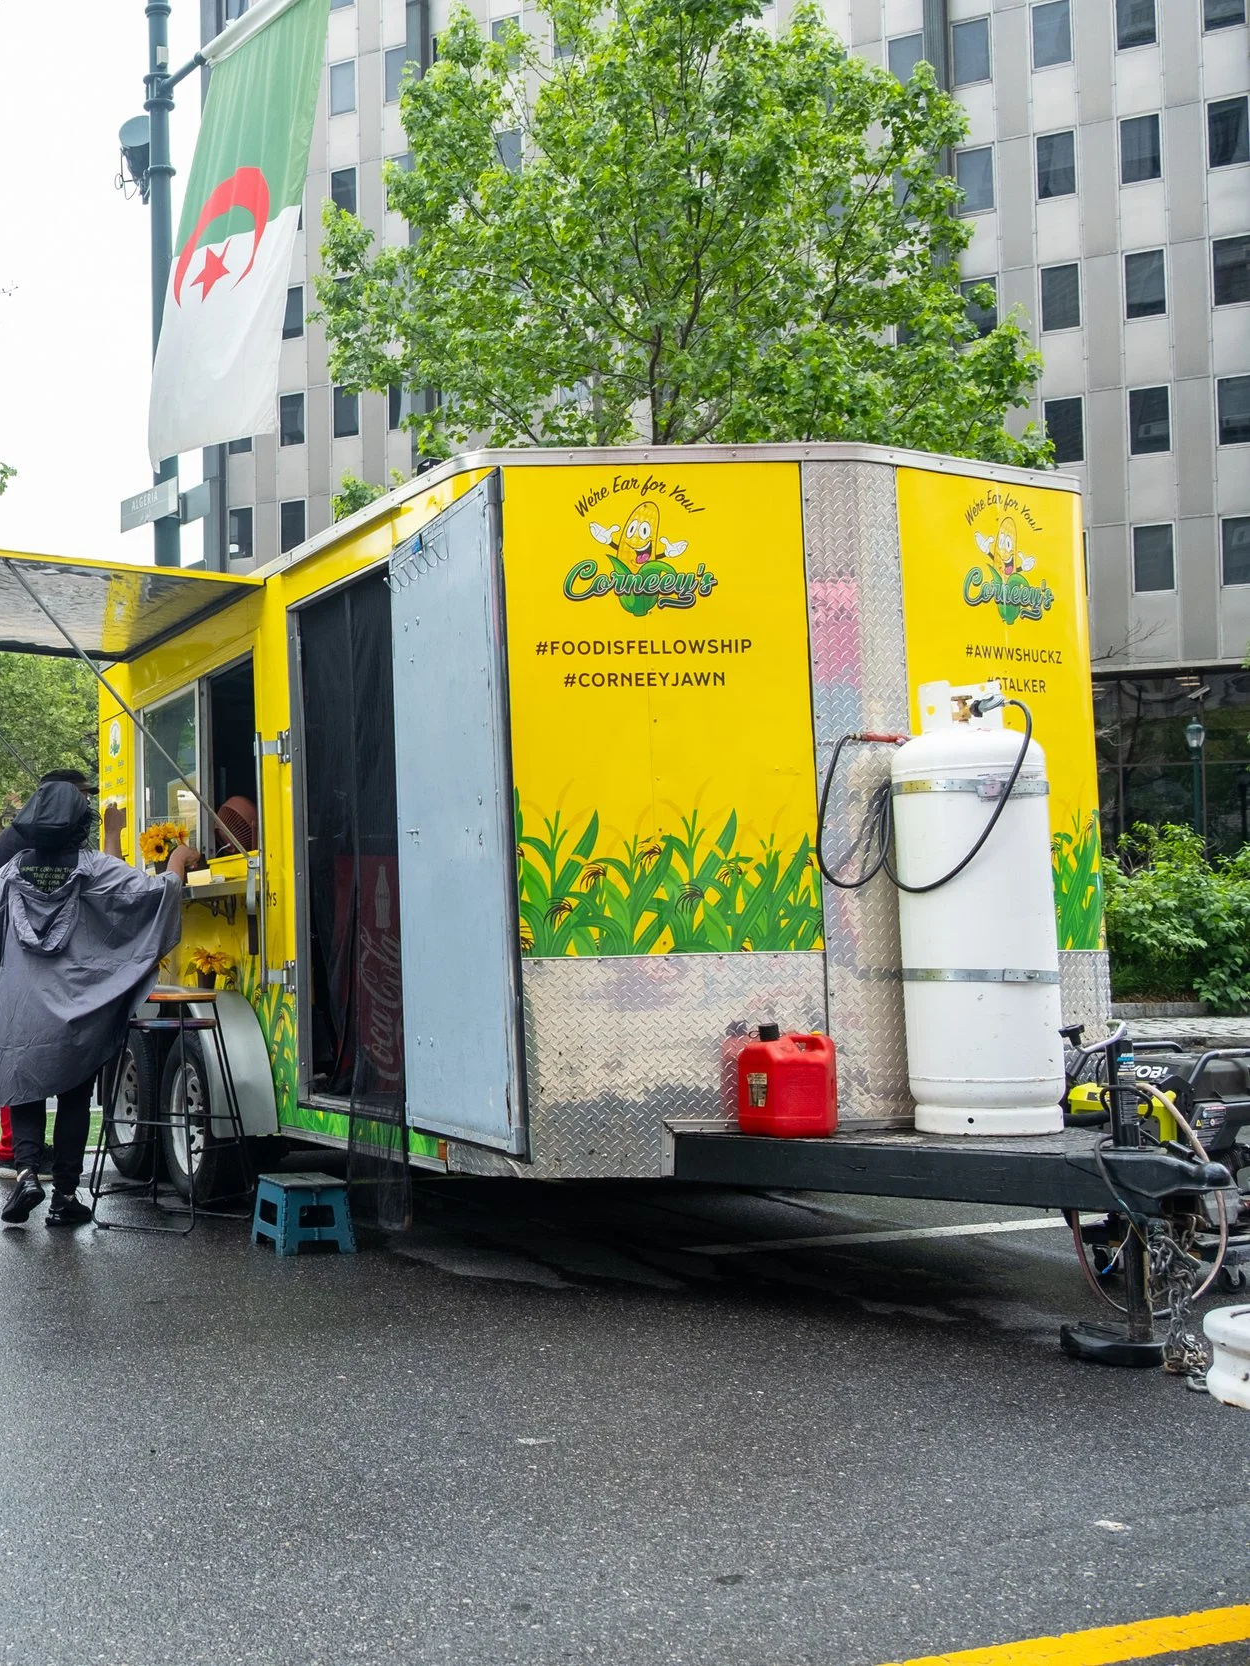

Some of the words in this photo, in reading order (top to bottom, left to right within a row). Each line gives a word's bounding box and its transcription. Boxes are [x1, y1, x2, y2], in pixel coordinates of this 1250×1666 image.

[131, 490, 159, 511] ALGERIA
[574, 486, 610, 517] We're
[612, 475, 640, 493] Ear
[640, 474, 667, 497] for
[668, 484, 706, 514] You!
[986, 489, 1003, 506] Ear
[1003, 493, 1019, 512] for
[1020, 504, 1043, 532] You!
[563, 559, 718, 609] Corneey's
[963, 566, 1054, 620] Corneey's
[535, 639, 752, 656] #FOODISFELLOWSHIP
[965, 644, 1063, 665] #AWWWSHUCKZ
[564, 671, 726, 688] #CORNEEYJAWN
